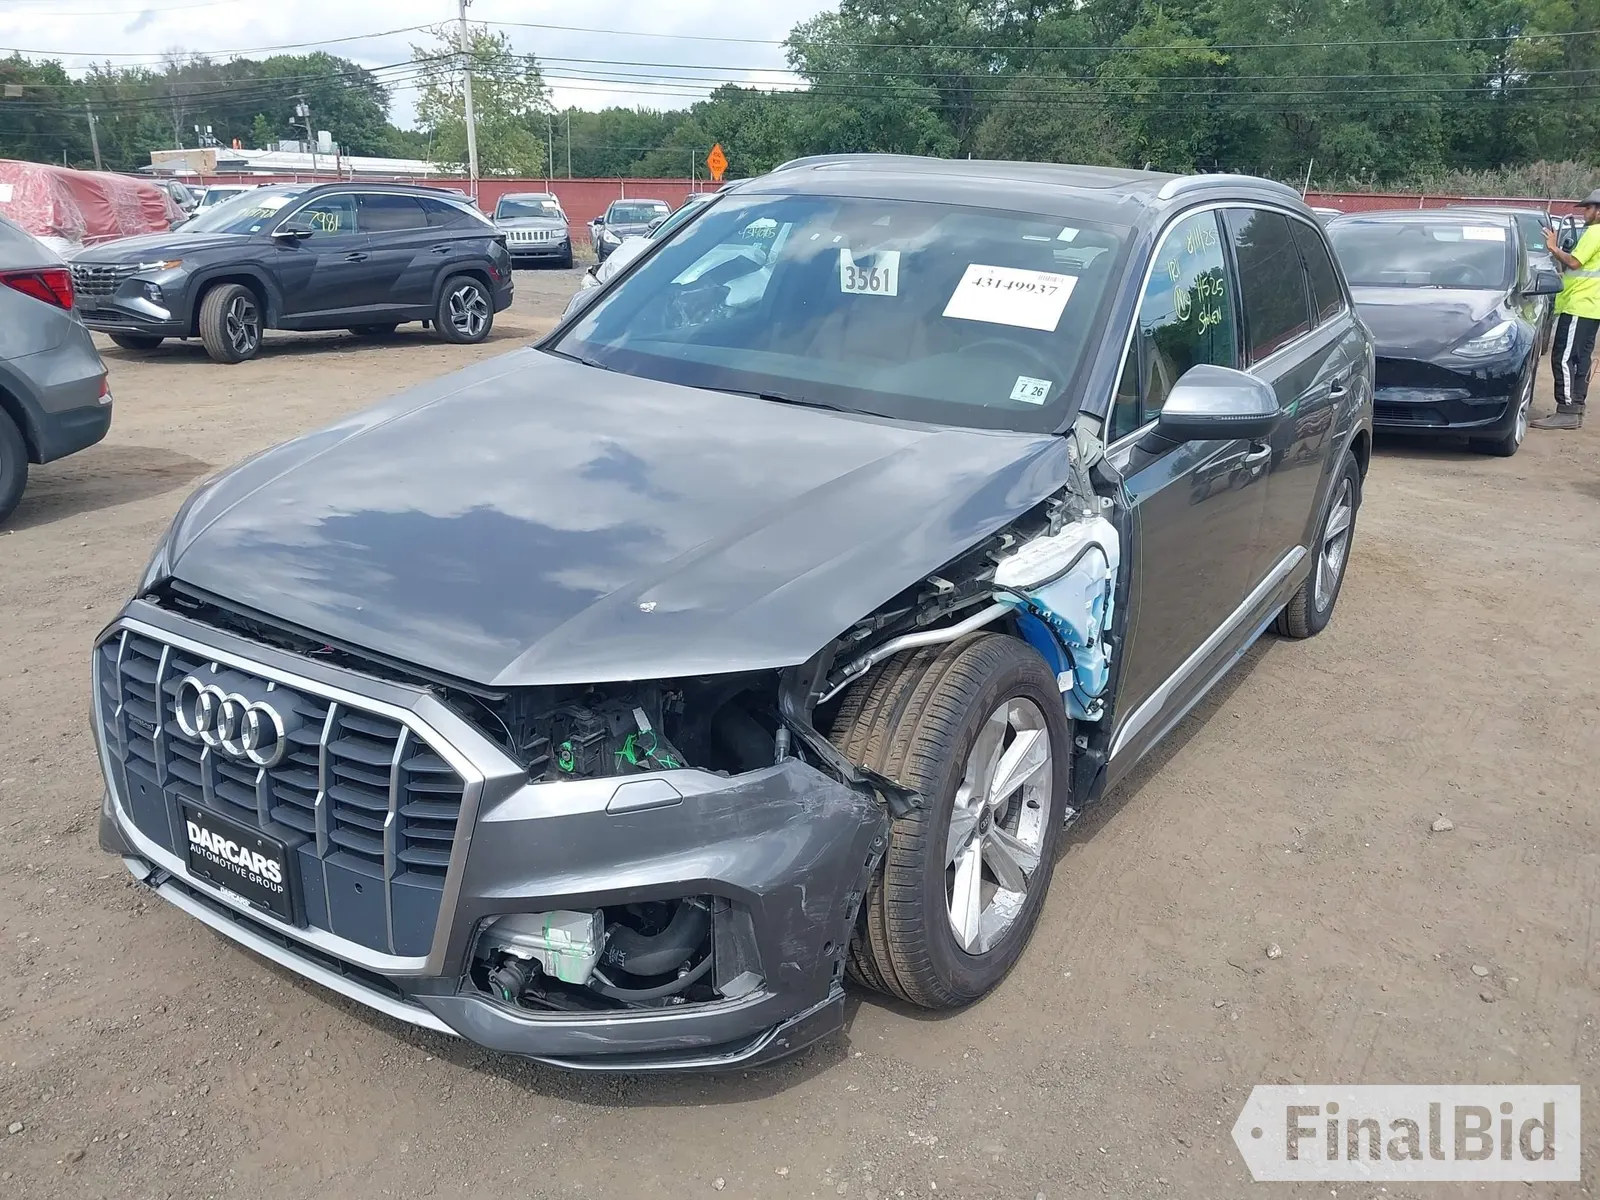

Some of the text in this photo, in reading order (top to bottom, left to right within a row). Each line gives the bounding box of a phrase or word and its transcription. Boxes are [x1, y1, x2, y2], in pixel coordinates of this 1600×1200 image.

[303, 210, 339, 232] 7981
[845, 266, 890, 292] 3561
[972, 277, 1059, 296] 43149937
[1020, 383, 1028, 393] 7
[1031, 386, 1044, 397] 26
[186, 820, 282, 884] DARCARS
[190, 843, 284, 894] AUTOMOTIVE GROUP
